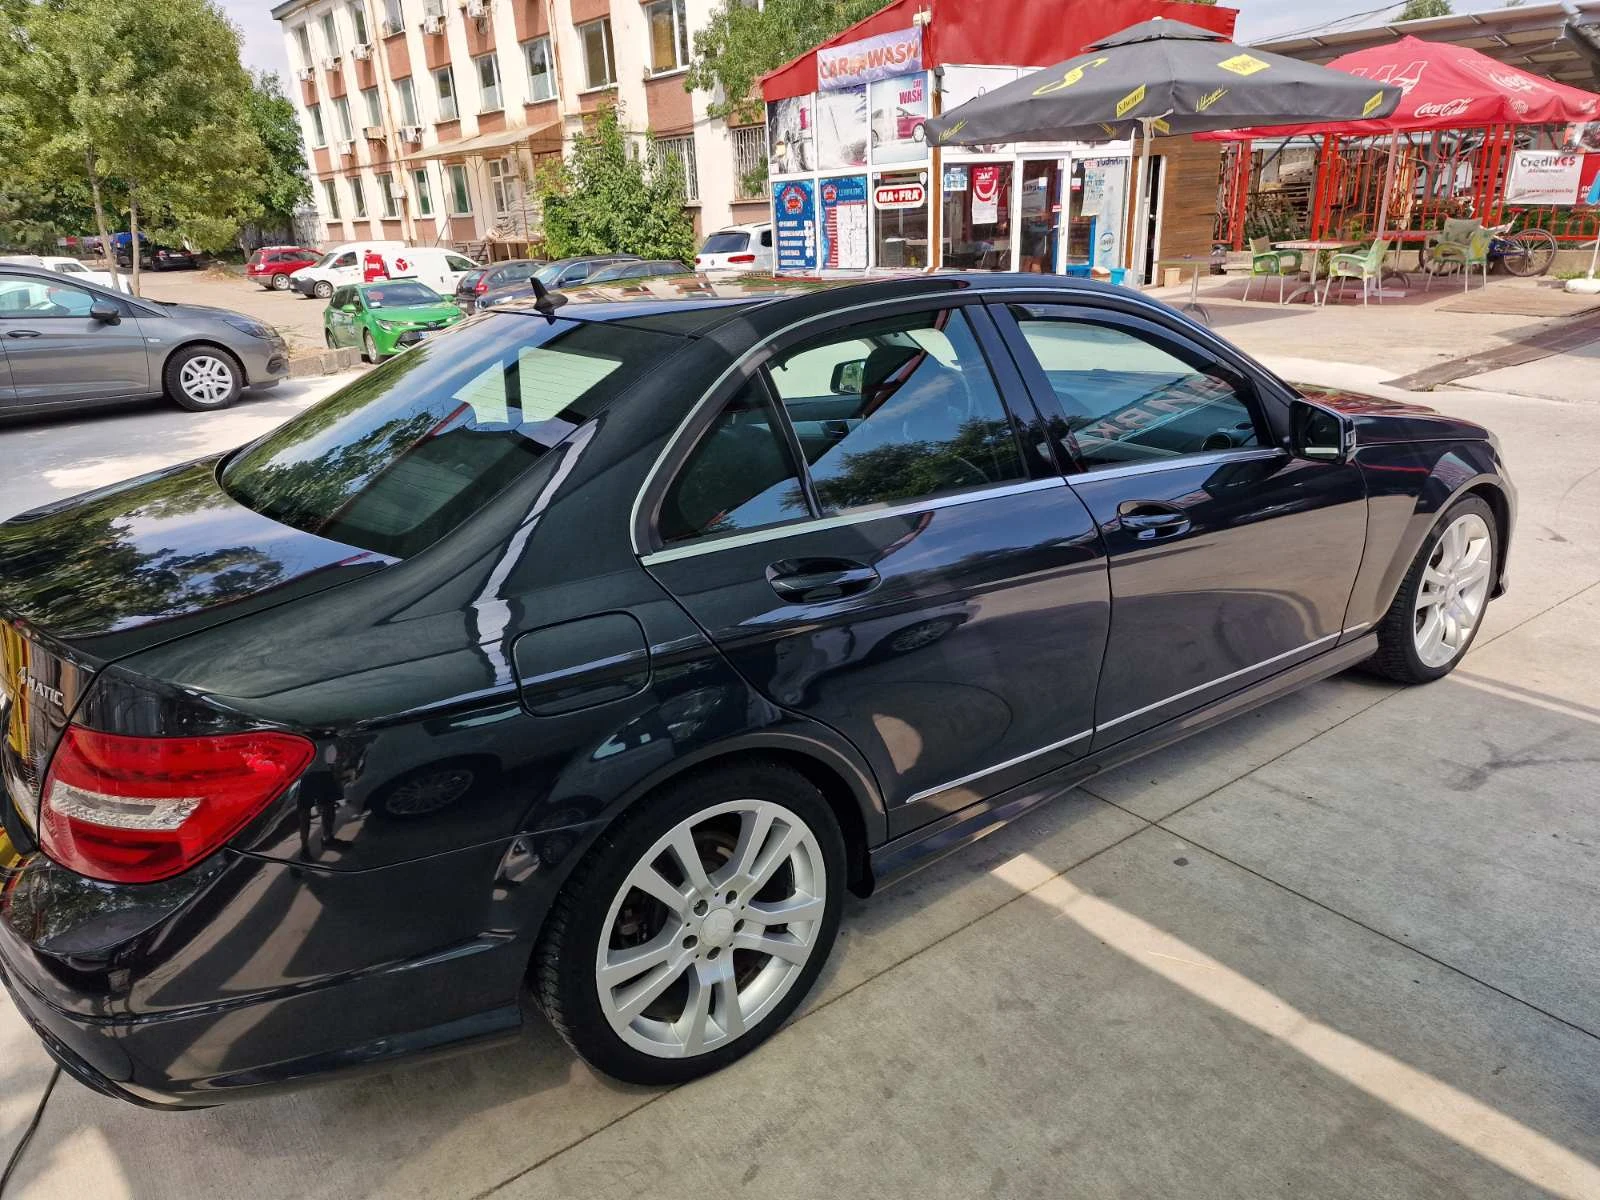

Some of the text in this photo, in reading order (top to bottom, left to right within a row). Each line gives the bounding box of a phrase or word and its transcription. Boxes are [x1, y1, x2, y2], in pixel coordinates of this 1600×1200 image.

[867, 41, 920, 69] WASH
[899, 89, 923, 105] WASH
[18, 666, 64, 707] 4MATIC
